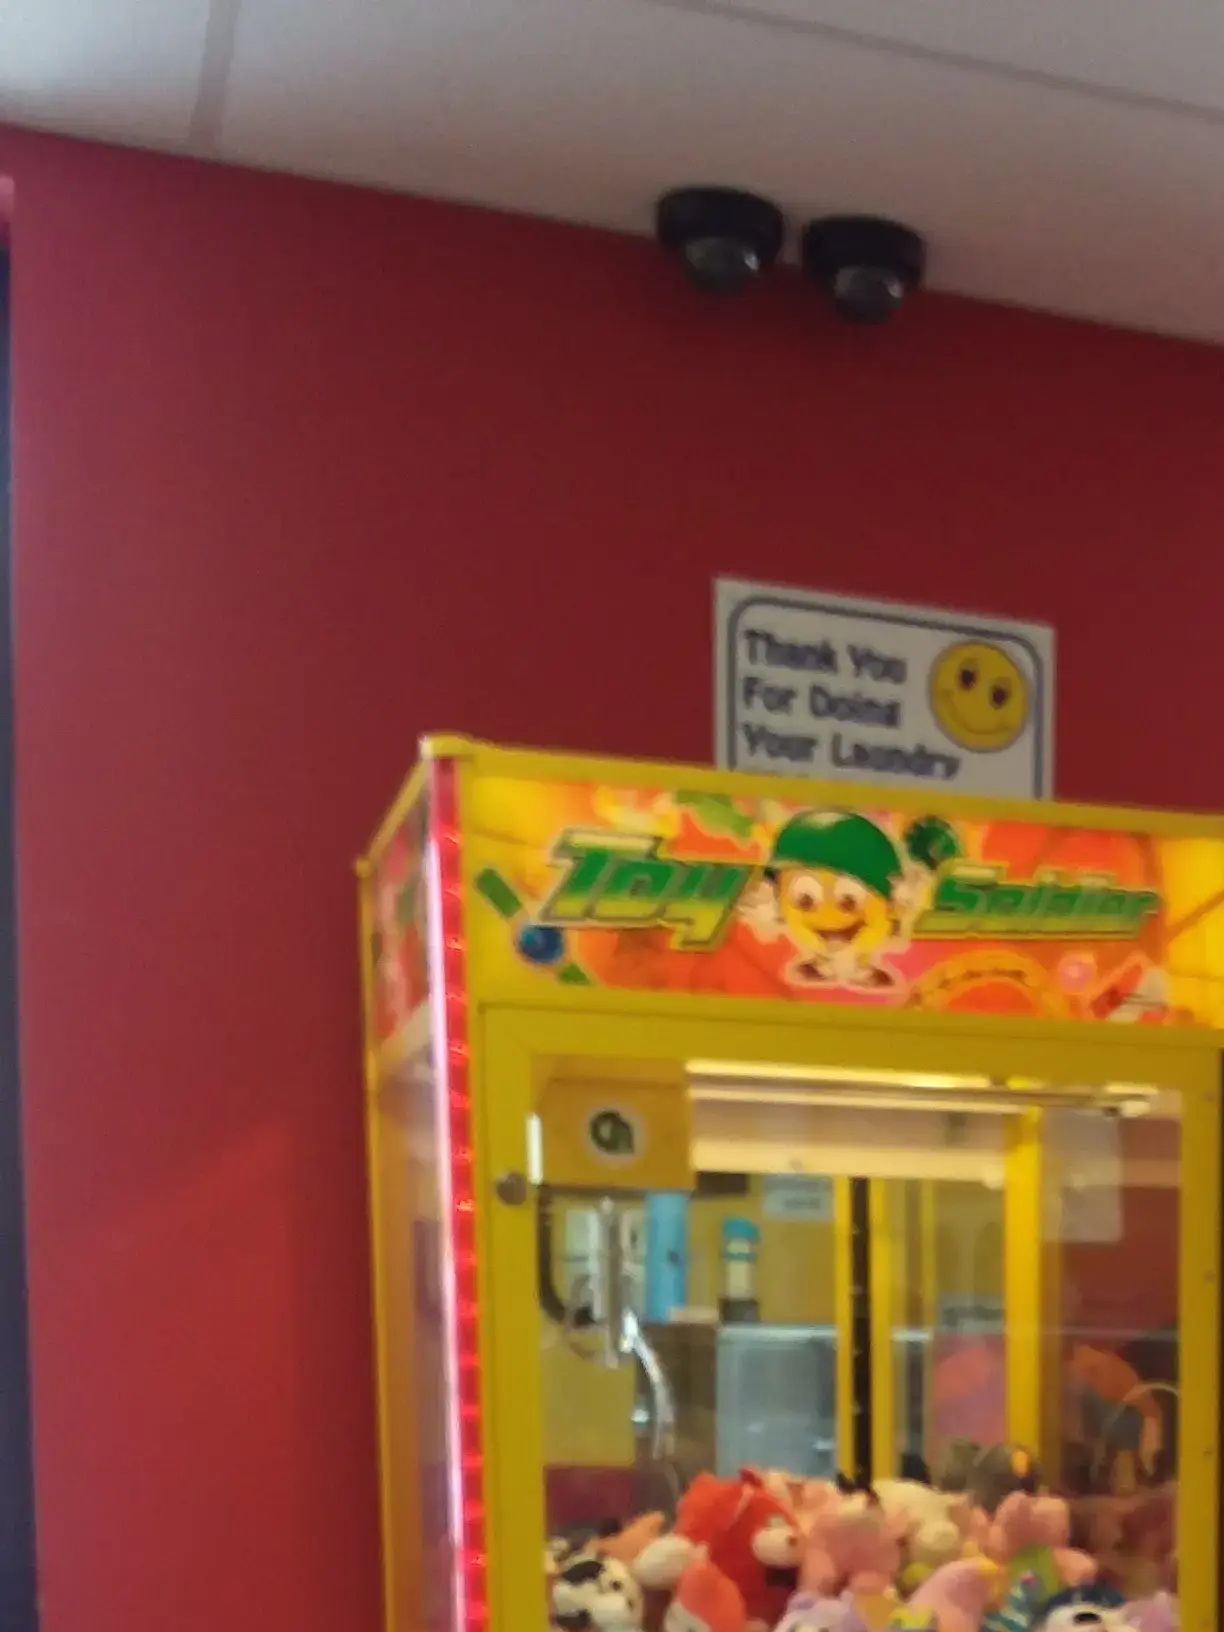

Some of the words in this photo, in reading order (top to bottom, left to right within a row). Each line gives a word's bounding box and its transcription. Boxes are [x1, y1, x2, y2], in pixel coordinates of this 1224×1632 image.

[743, 629, 837, 674] Thank
[846, 643, 907, 684] You
[743, 676, 796, 713] For
[810, 684, 901, 728] Doing
[741, 721, 817, 763] Your
[831, 732, 961, 781] Laundry
